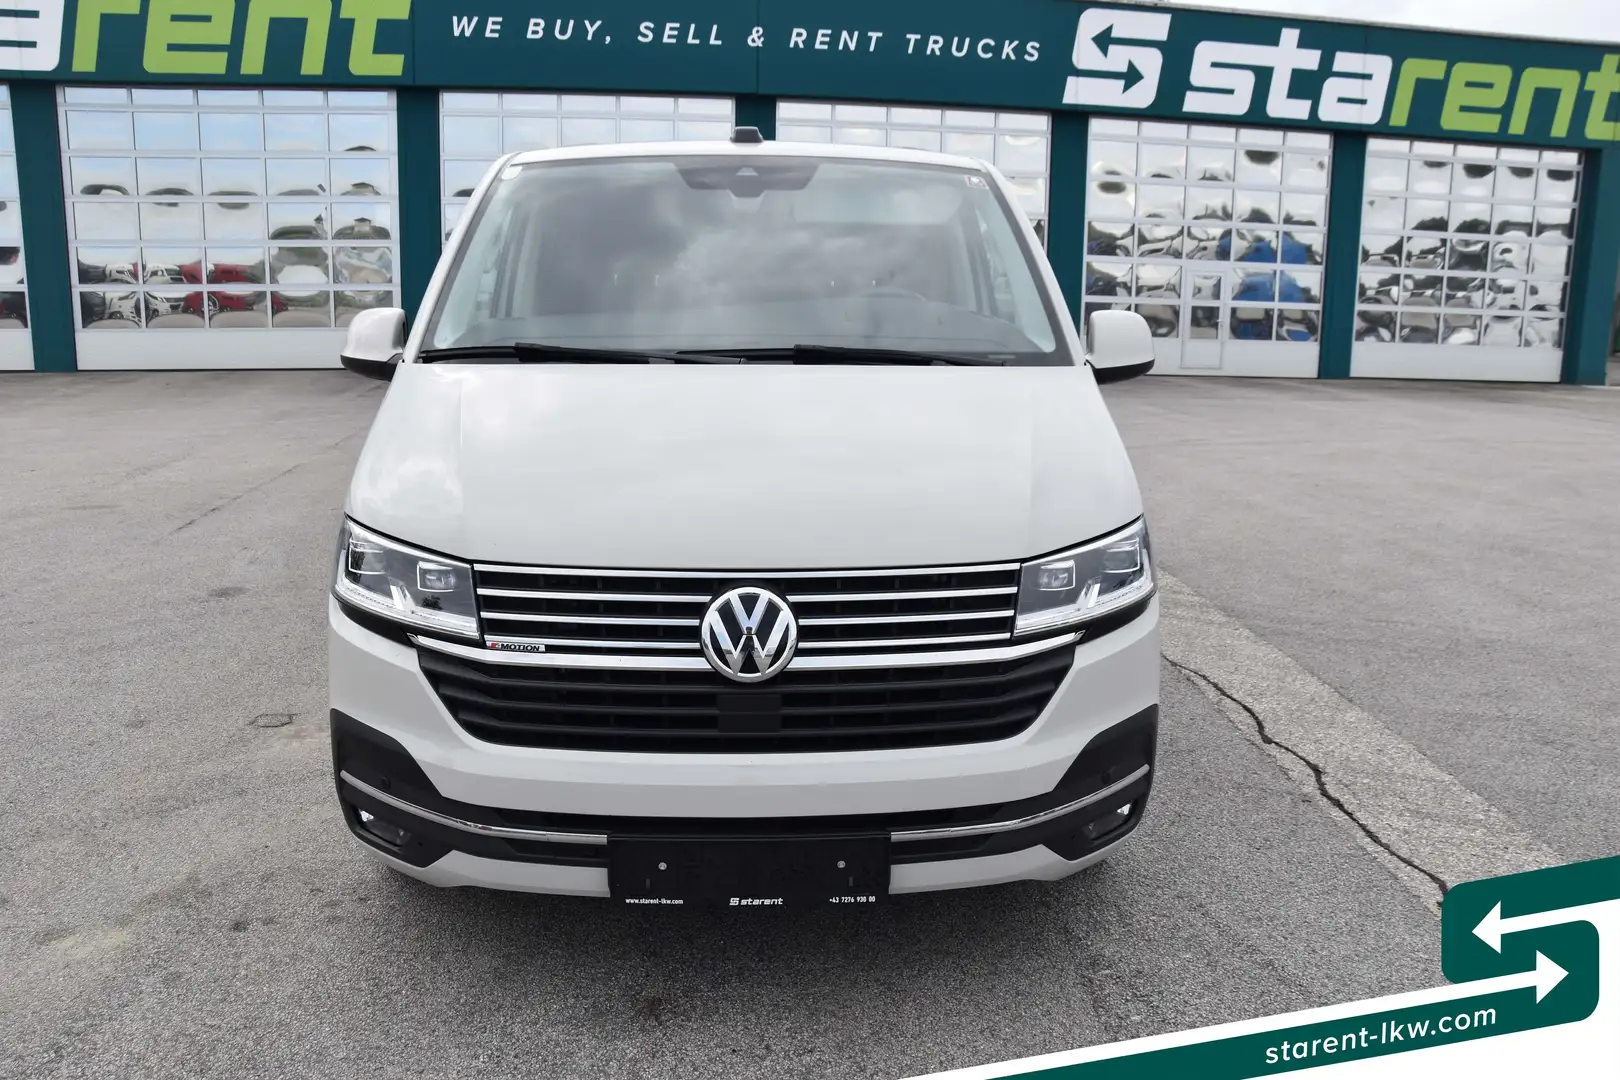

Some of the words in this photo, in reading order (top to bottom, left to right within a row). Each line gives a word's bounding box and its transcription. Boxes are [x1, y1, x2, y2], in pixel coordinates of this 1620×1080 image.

[452, 15, 503, 38] WE
[526, 18, 611, 45] BUY,
[637, 21, 722, 45] SELL
[747, 26, 765, 47] &
[789, 27, 883, 52] RENT
[905, 33, 1040, 62] TRUCKS
[1183, 27, 1620, 141] starent
[625, 897, 684, 905] www.starent-lkw.com
[741, 897, 784, 906] starent
[856, 895, 867, 903] 930
[868, 895, 876, 903] 00
